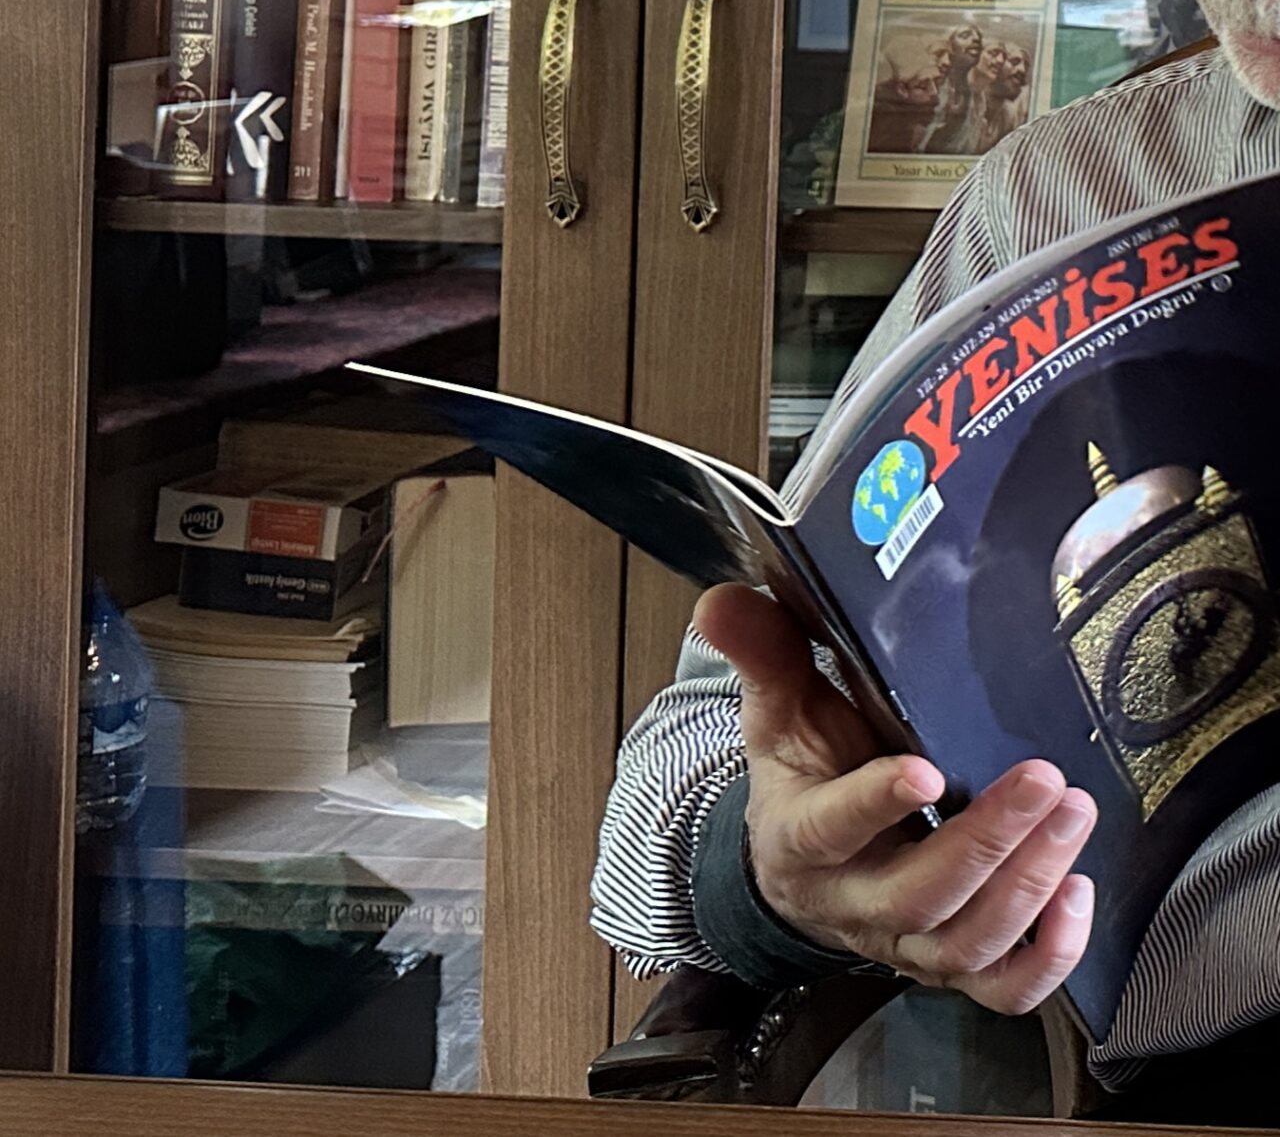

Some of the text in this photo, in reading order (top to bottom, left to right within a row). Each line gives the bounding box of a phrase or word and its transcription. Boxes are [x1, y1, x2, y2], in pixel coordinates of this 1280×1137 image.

[416, 81, 437, 162] İSLÂMA
[1014, 377, 1044, 405] Bir
[1047, 322, 1129, 383] Dünyaya
[182, 509, 220, 531] Bion
